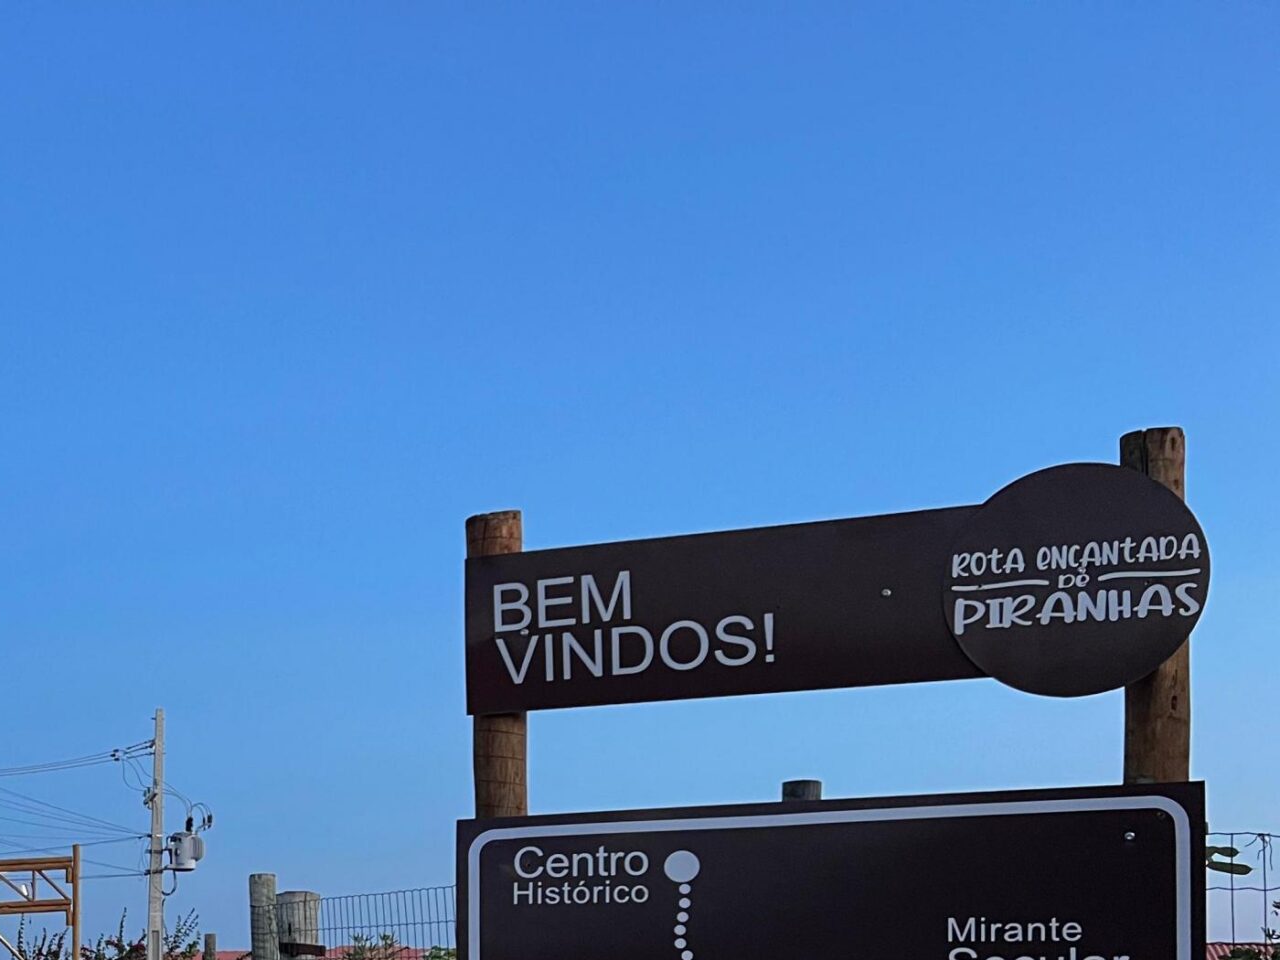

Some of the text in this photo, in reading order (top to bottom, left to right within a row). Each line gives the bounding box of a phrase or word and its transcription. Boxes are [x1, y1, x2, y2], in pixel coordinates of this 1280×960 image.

[493, 570, 631, 633] BEM
[953, 582, 1201, 636] PIRANHAS
[495, 613, 775, 684] VINDOS!
[513, 845, 649, 879] Centro
[513, 879, 649, 905] Histórico
[947, 916, 1082, 943] Mirante
